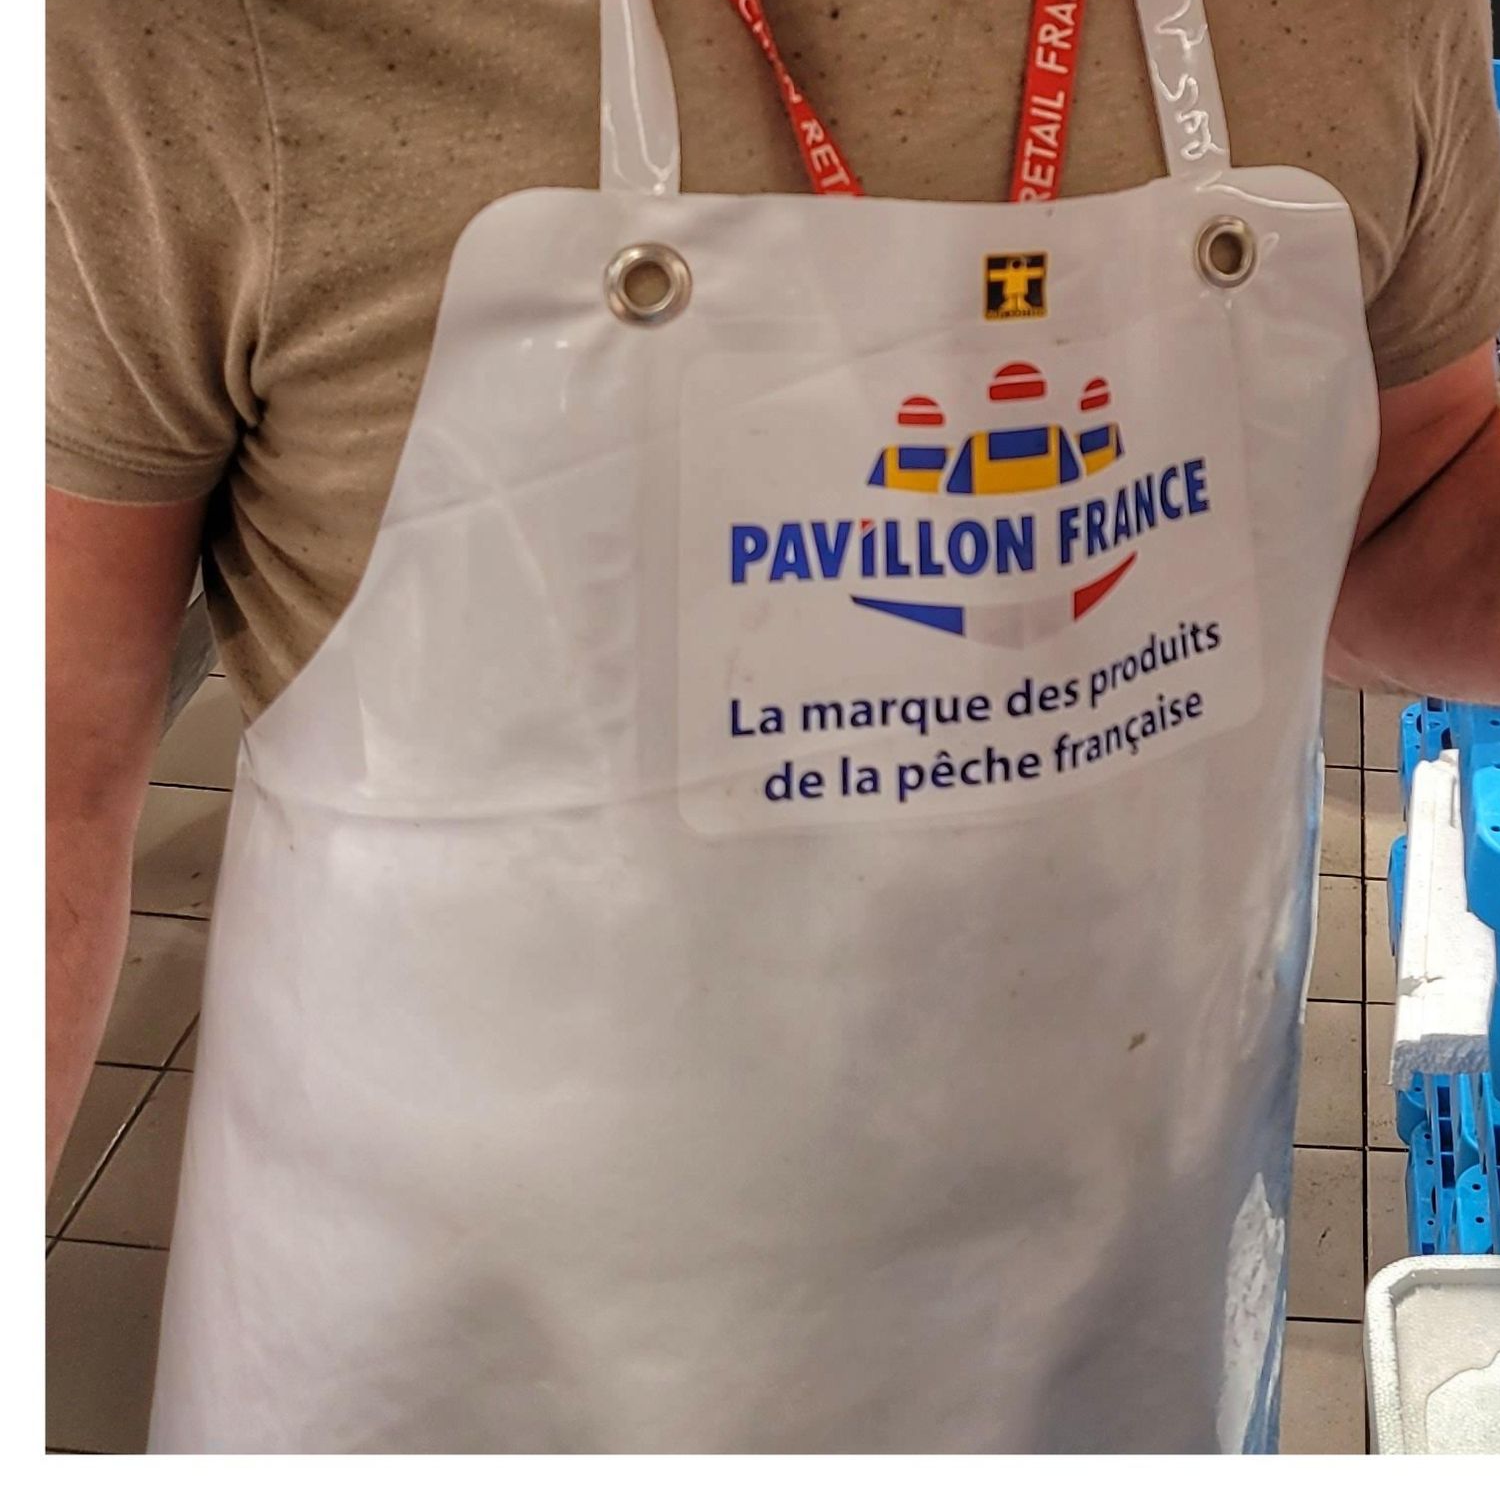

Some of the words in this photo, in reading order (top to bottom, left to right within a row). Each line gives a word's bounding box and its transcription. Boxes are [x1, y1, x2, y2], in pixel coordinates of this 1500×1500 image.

[1018, 89, 1066, 203] RETAIL
[1057, 455, 1212, 567] FRANCE
[729, 698, 786, 739] La
[801, 687, 992, 737] marque
[1006, 677, 1081, 718] des
[1088, 618, 1223, 704] produits
[764, 761, 827, 803] de
[840, 756, 881, 797] la
[897, 746, 1043, 803] pêche
[1054, 687, 1206, 776] française
